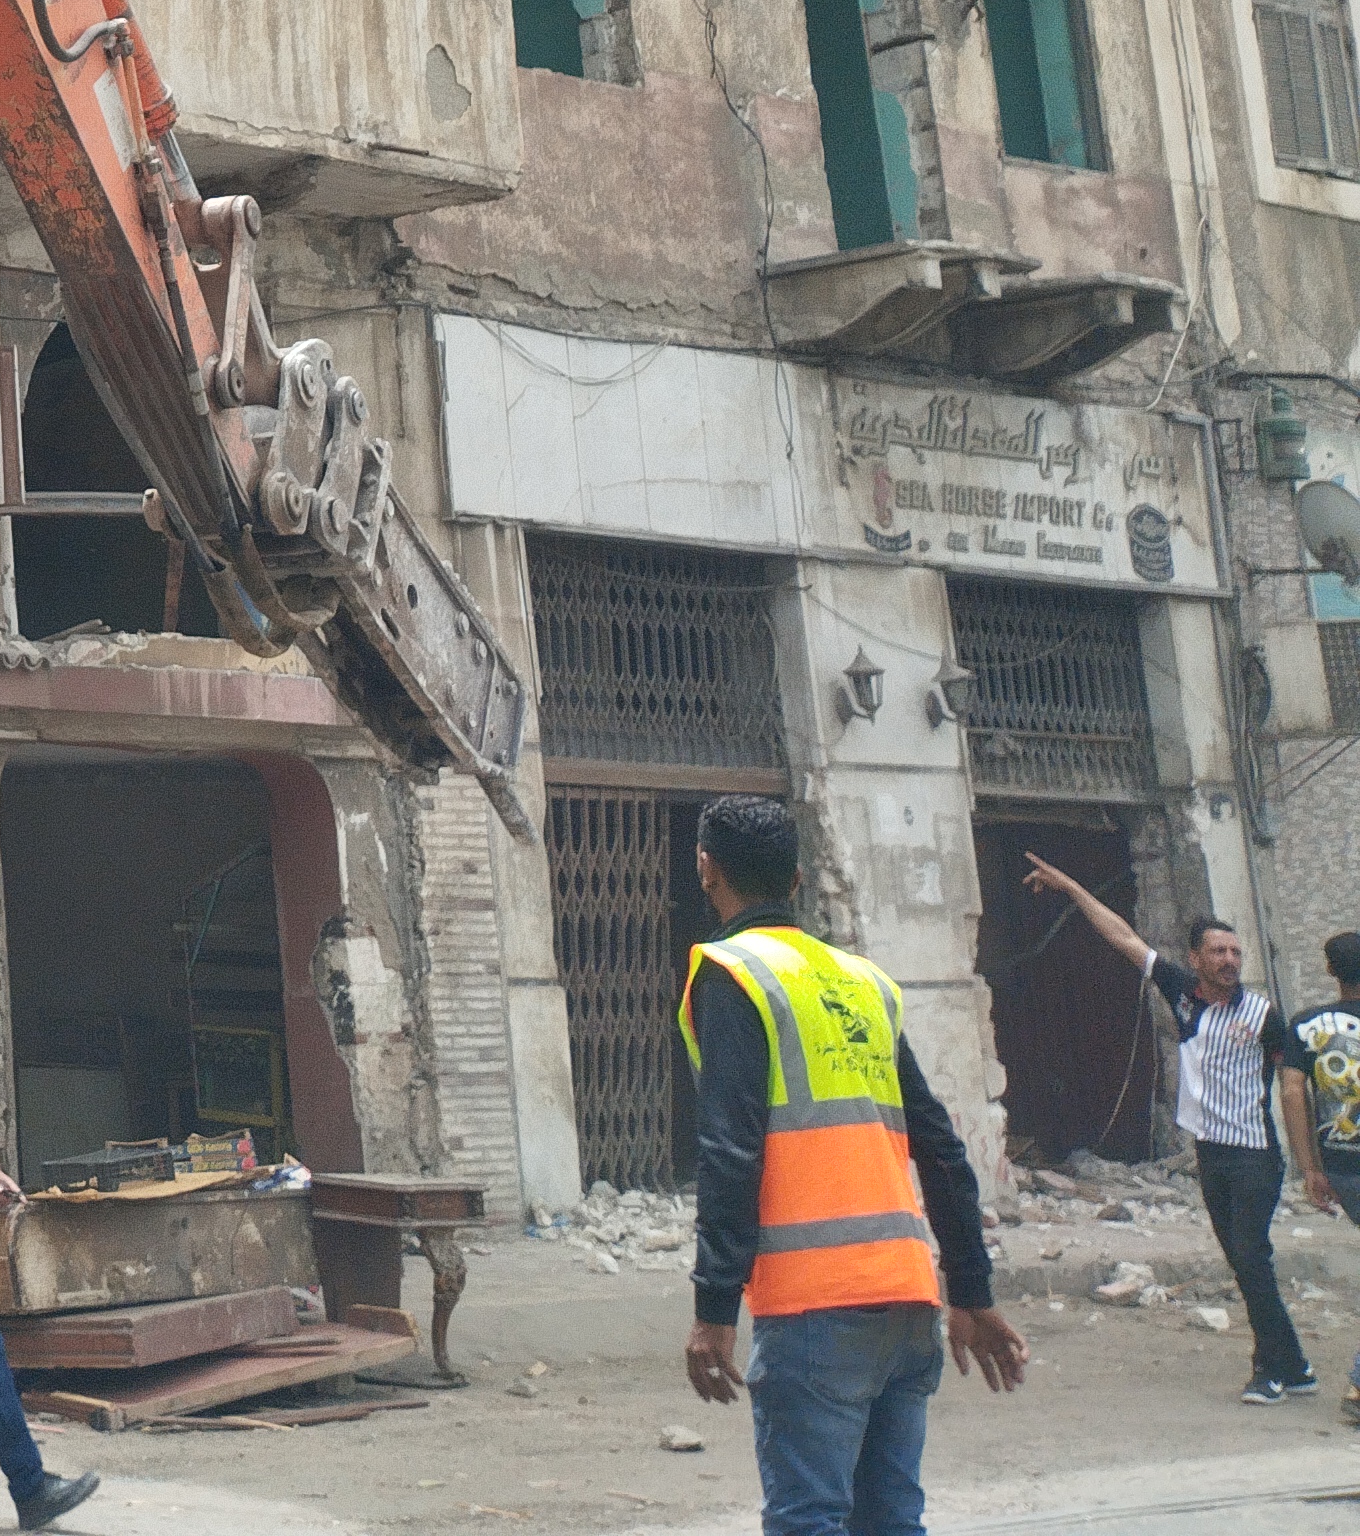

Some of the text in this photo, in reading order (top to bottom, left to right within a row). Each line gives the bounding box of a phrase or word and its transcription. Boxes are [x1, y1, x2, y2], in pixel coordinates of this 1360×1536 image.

[894, 478, 934, 513] SEA
[940, 481, 1008, 520] HORSE
[1012, 491, 1087, 528] IMPORT
